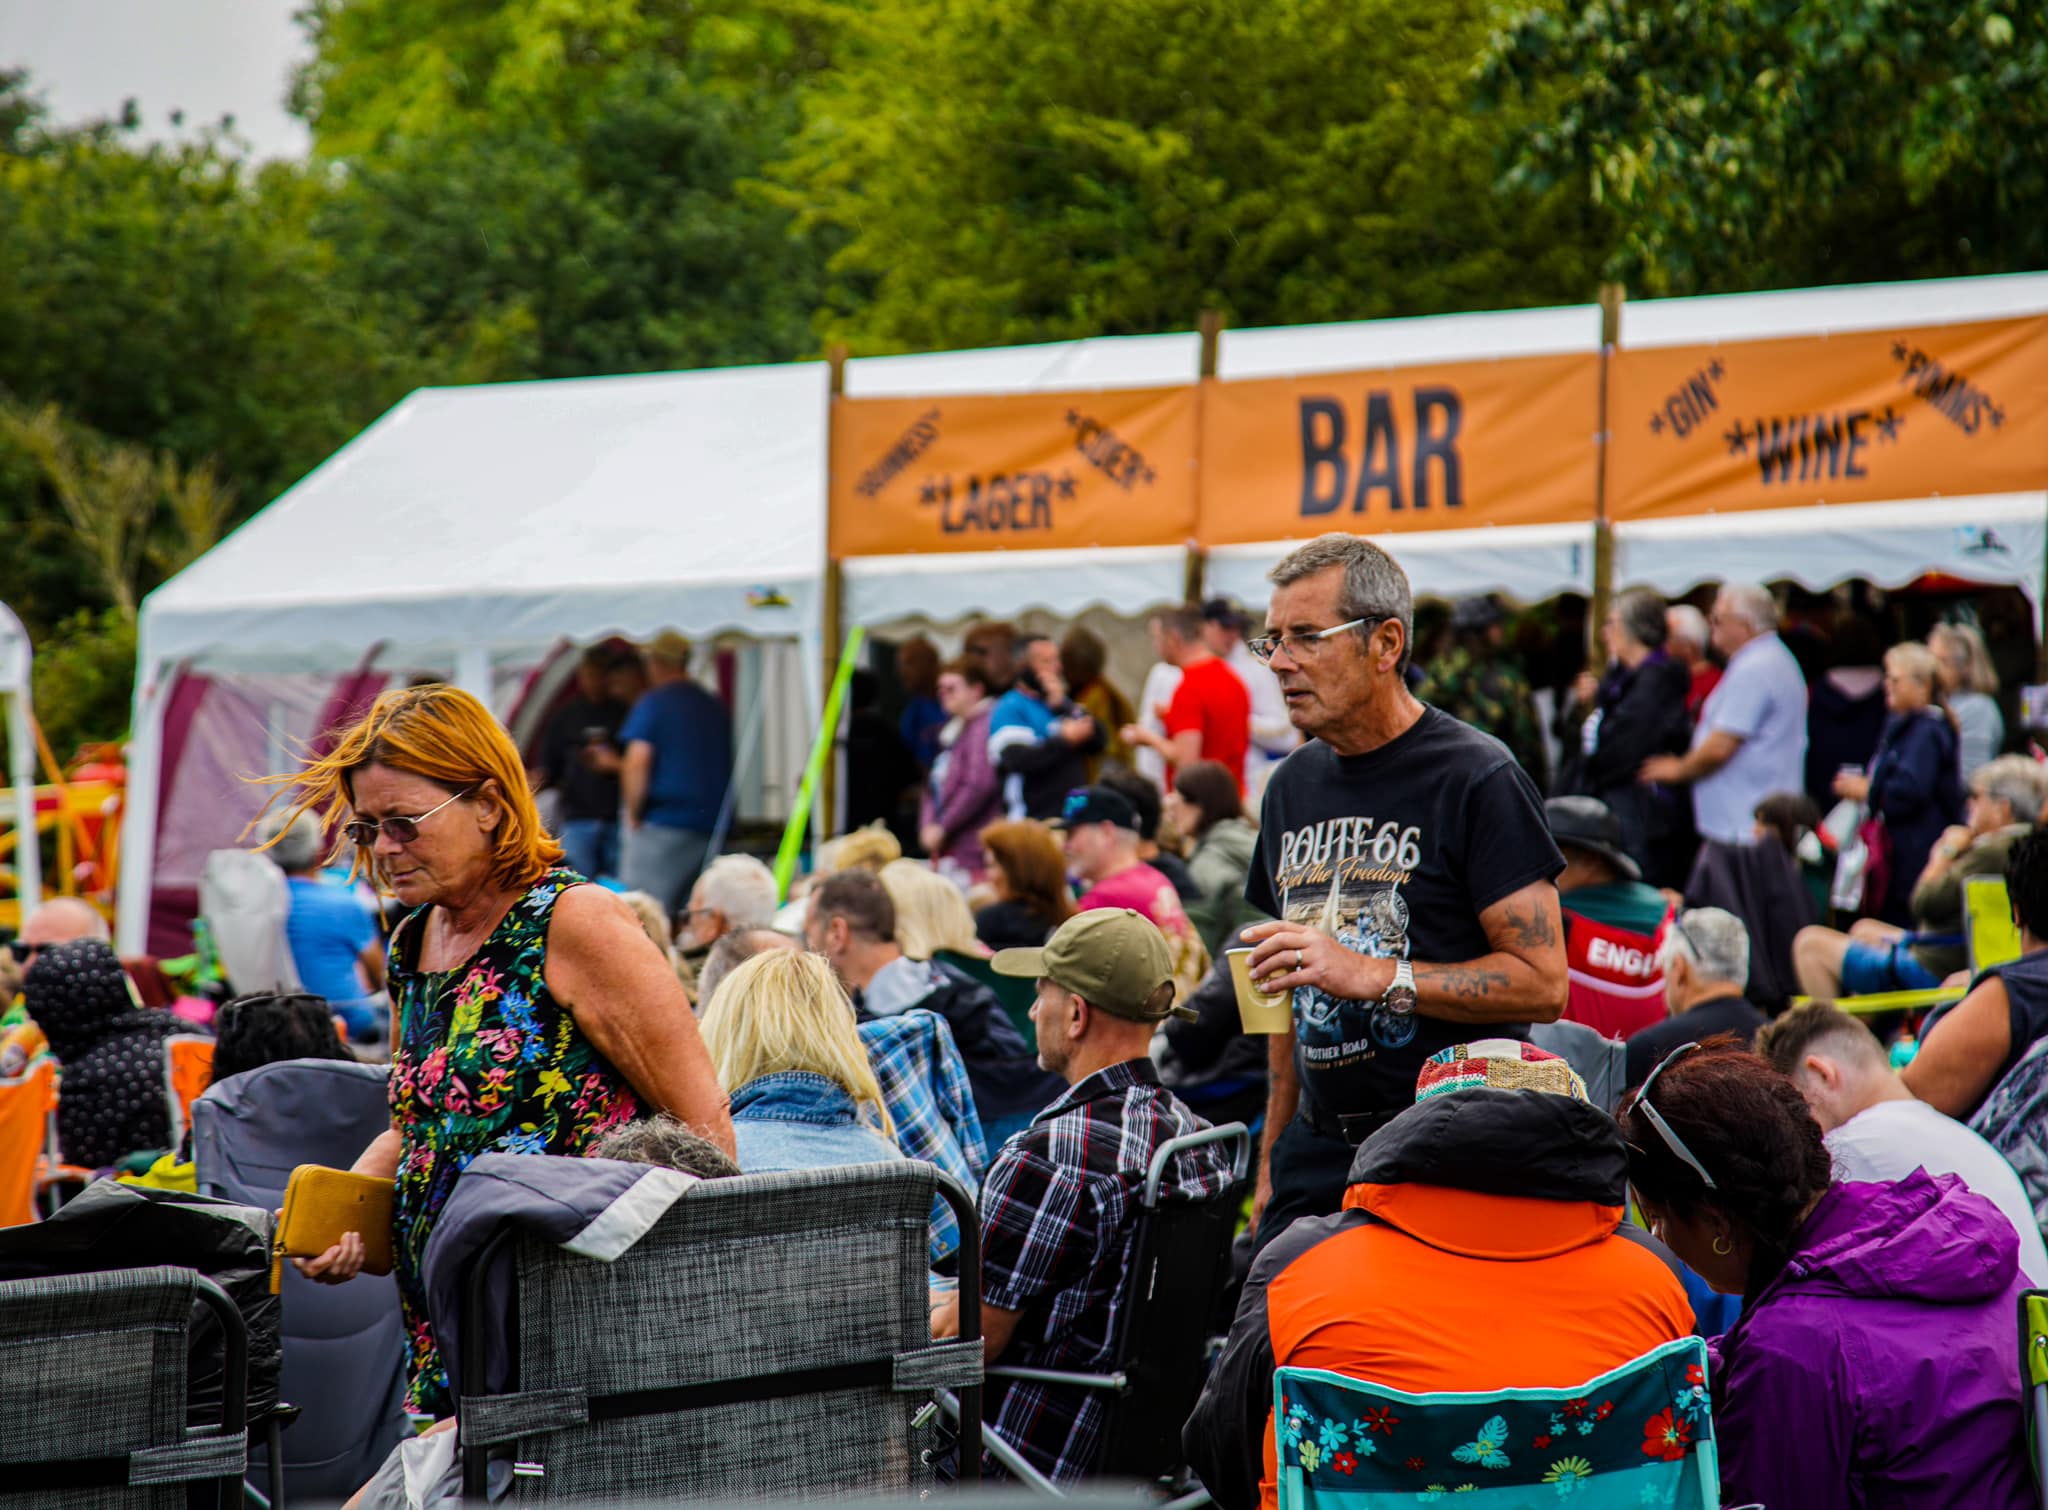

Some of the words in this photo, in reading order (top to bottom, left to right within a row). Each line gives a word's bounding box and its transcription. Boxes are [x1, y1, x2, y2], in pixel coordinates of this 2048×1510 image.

[1666, 369, 1717, 439] GIN
[1299, 385, 1463, 517] BAR
[1755, 411, 1872, 485] WINE
[940, 473, 1053, 533] LAGER
[1279, 816, 1374, 885] ROUTE
[1373, 821, 1422, 871] 66
[1306, 862, 1334, 885] the
[1336, 856, 1412, 886] Freedom
[1341, 1038, 1368, 1056] ROAD
